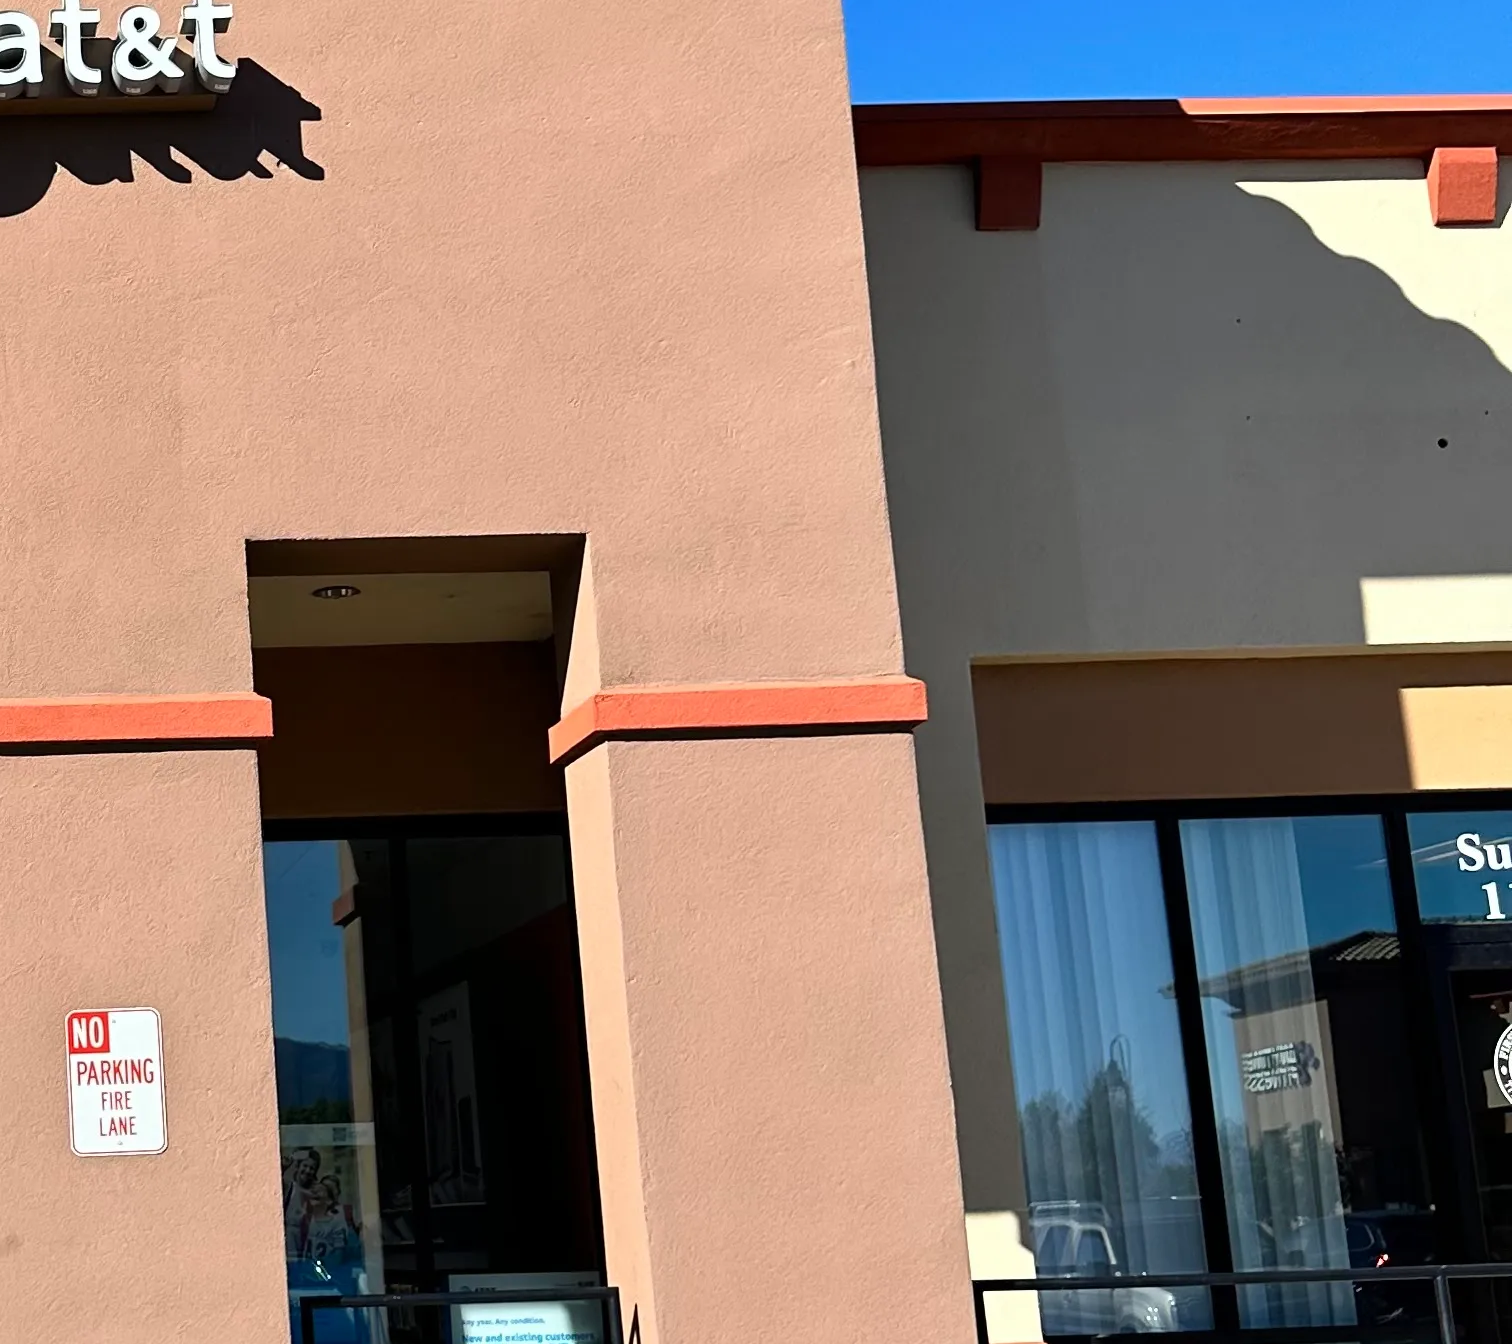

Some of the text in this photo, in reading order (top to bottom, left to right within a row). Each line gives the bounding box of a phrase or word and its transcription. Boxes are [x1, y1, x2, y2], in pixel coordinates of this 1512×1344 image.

[1456, 833, 1512, 871] Su
[1481, 881, 1512, 920] 1
[72, 1016, 105, 1049] NO
[77, 1058, 154, 1086] PARKING
[101, 1091, 133, 1111] FIRE
[99, 1116, 138, 1137] LANE
[486, 1333, 503, 1343] and
[505, 1332, 543, 1344] existing
[545, 1332, 594, 1341] customers
